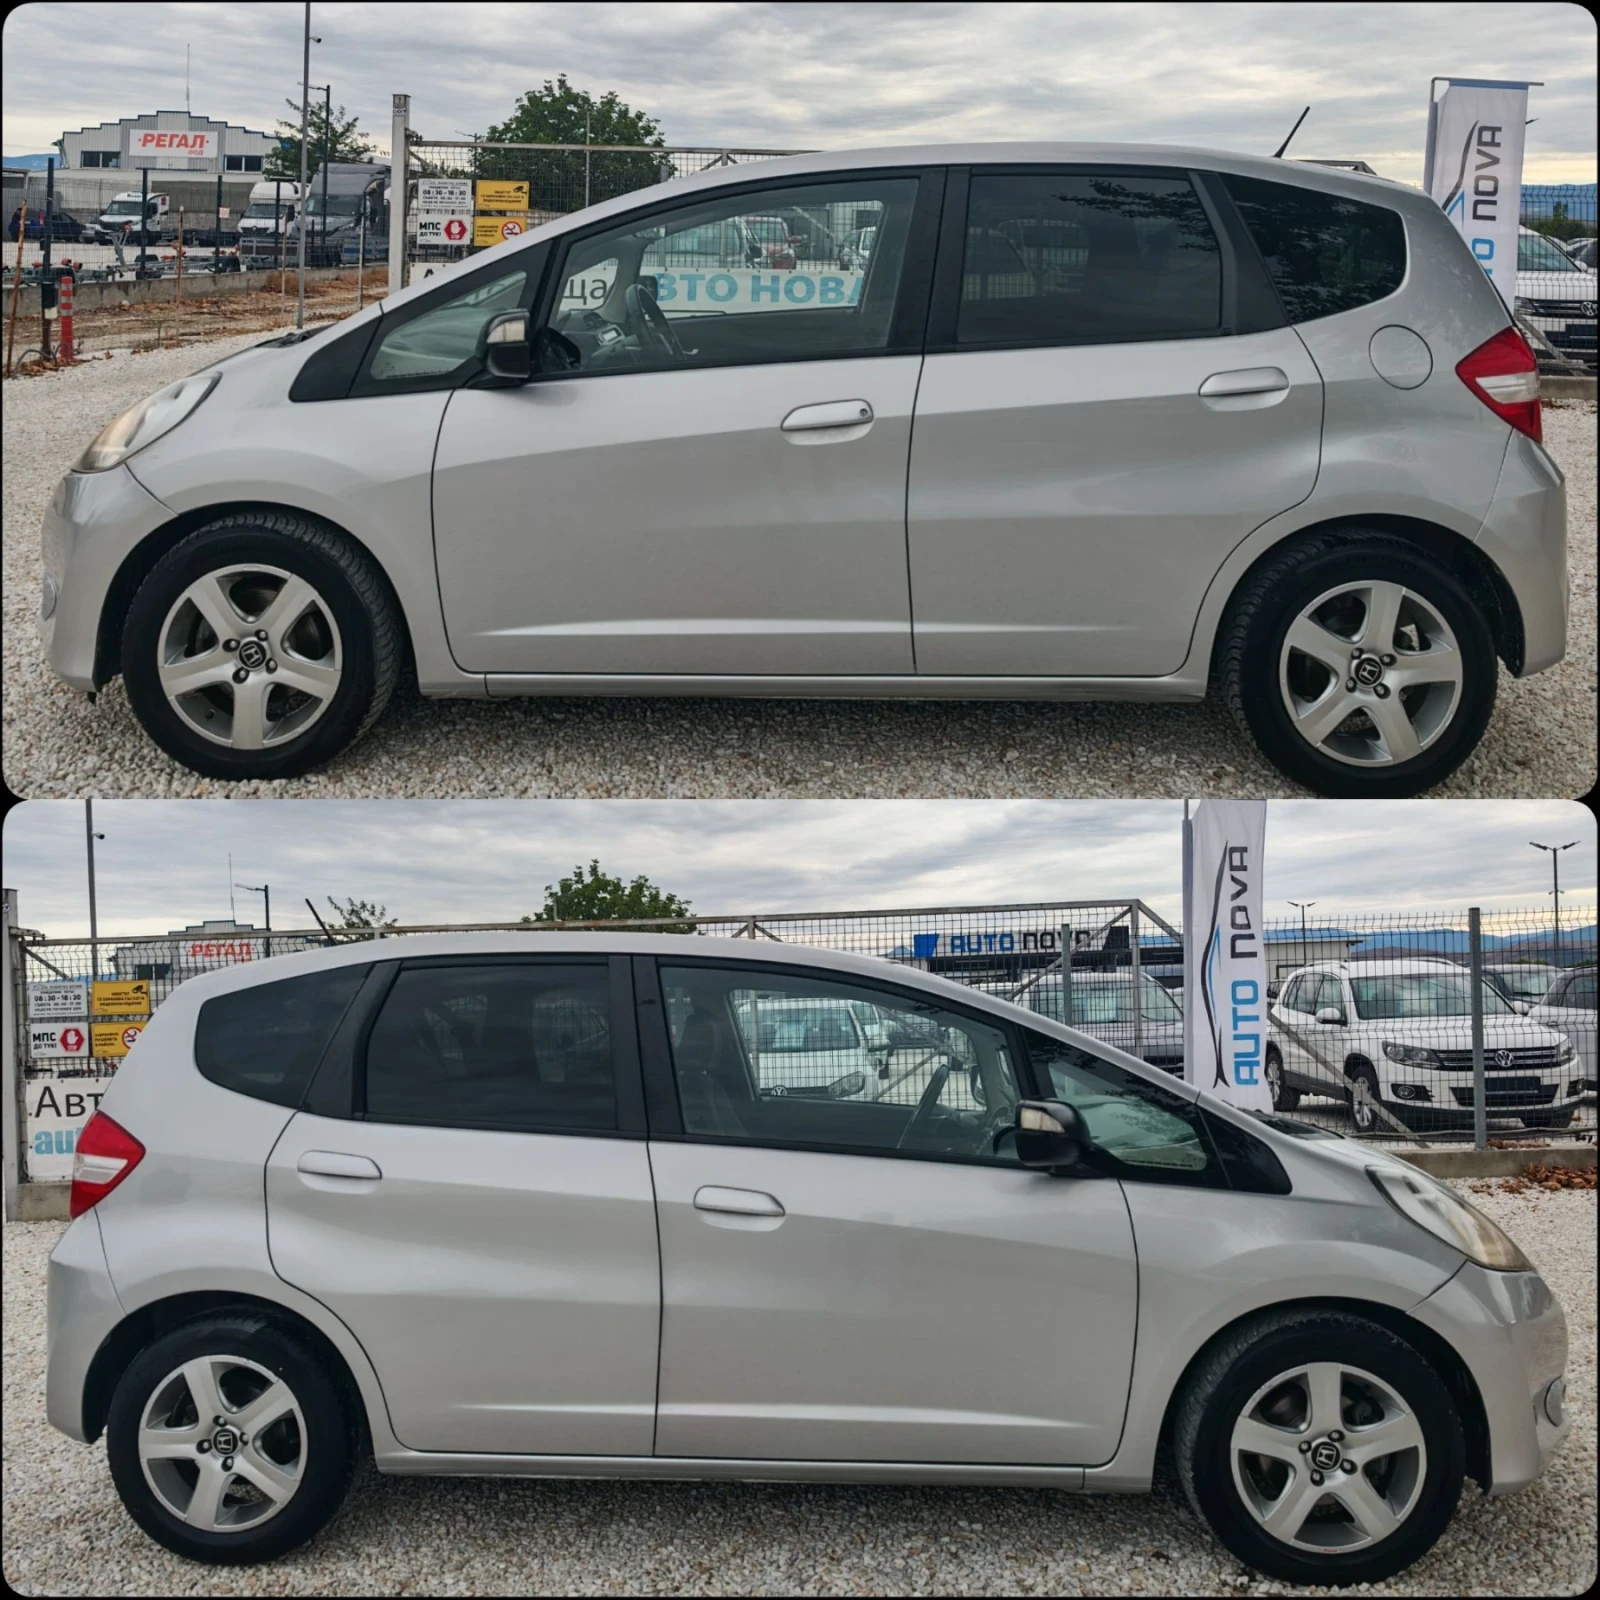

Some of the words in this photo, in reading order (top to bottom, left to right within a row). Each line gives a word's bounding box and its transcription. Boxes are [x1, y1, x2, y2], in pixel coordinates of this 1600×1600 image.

[141, 133, 206, 149] РЕГАЛ
[419, 222, 441, 231] МПС
[655, 273, 739, 302] ВТО
[951, 933, 1015, 953] AUTO
[32, 1032, 57, 1042] МПС
[1231, 980, 1261, 1086] AUTO
